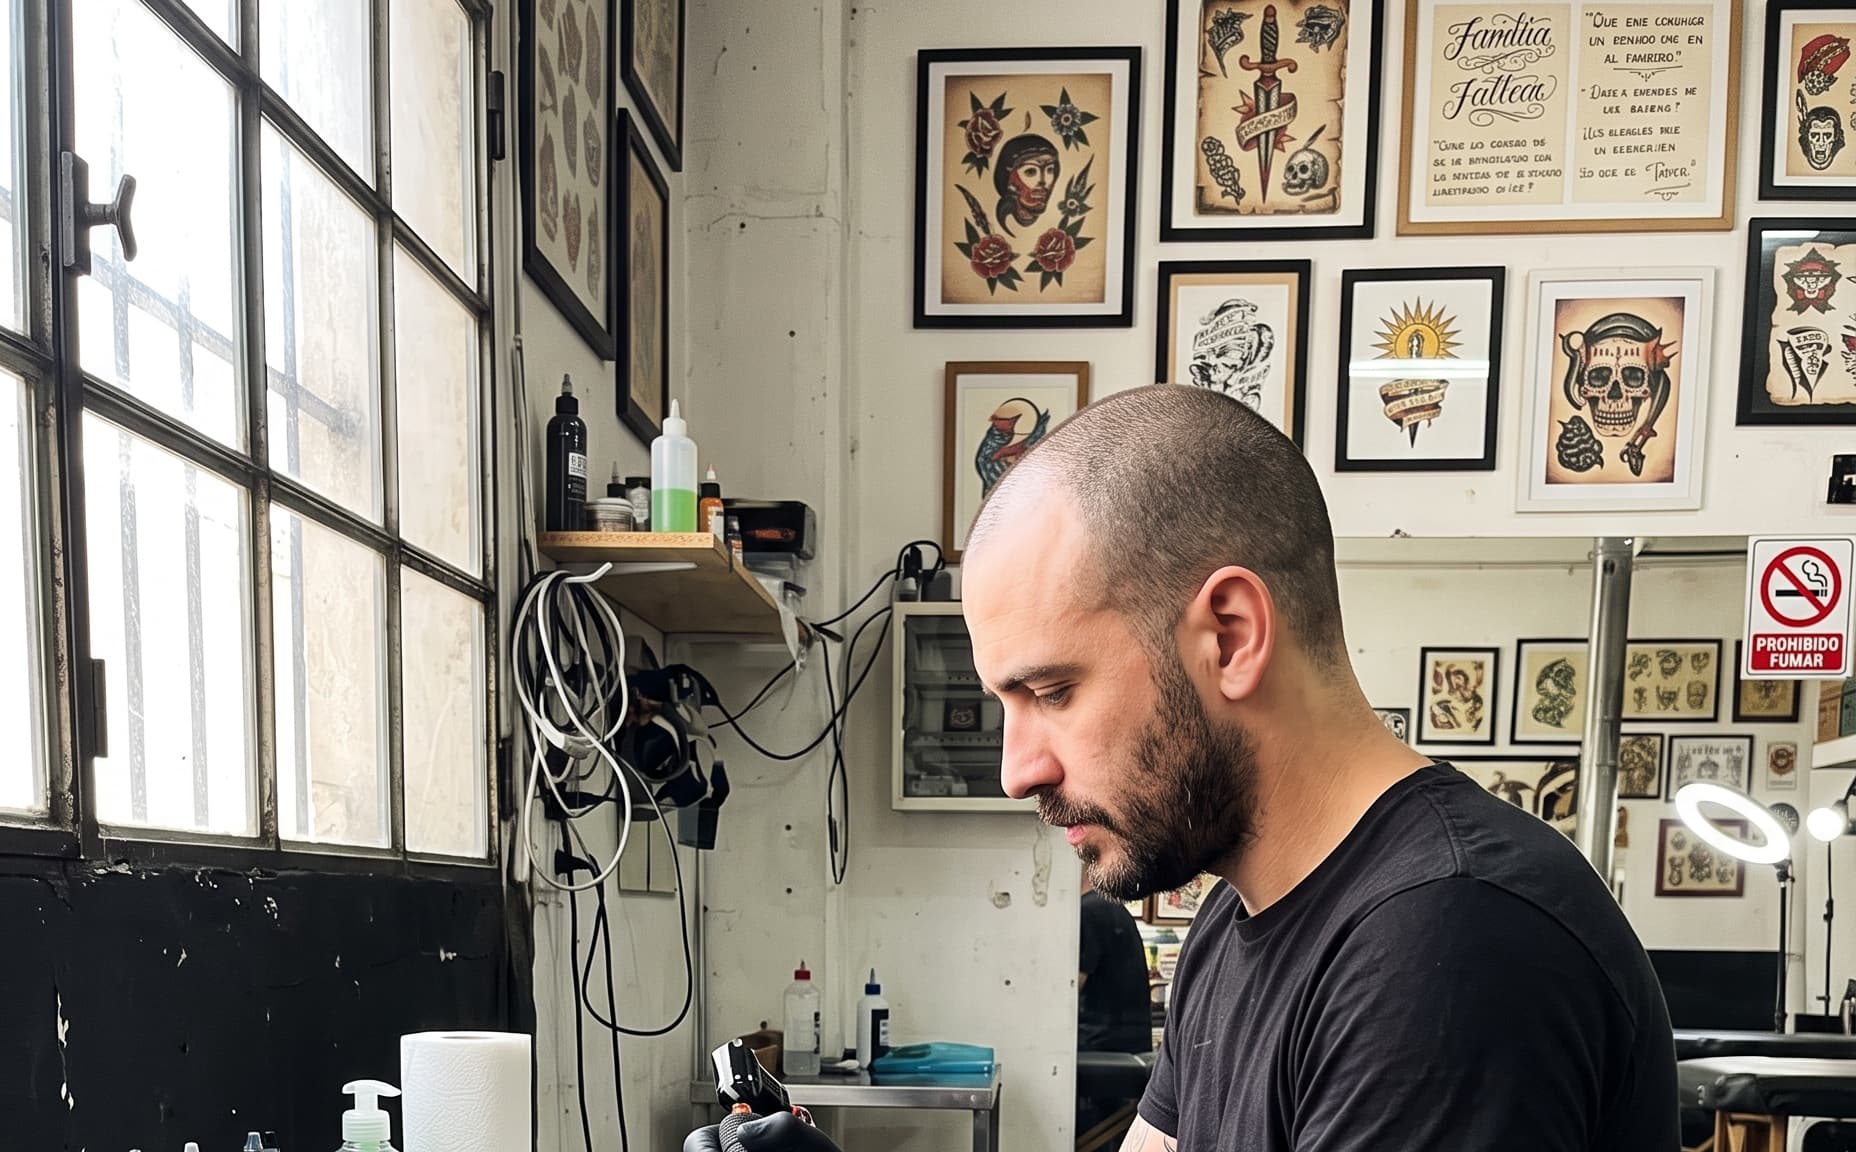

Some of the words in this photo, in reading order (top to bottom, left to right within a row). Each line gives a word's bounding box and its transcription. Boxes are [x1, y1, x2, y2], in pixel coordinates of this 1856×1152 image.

[1688, 35, 1703, 45] EN
[1756, 636, 1839, 651] PROHIBIDO
[1769, 653, 1824, 668] FUMAR
